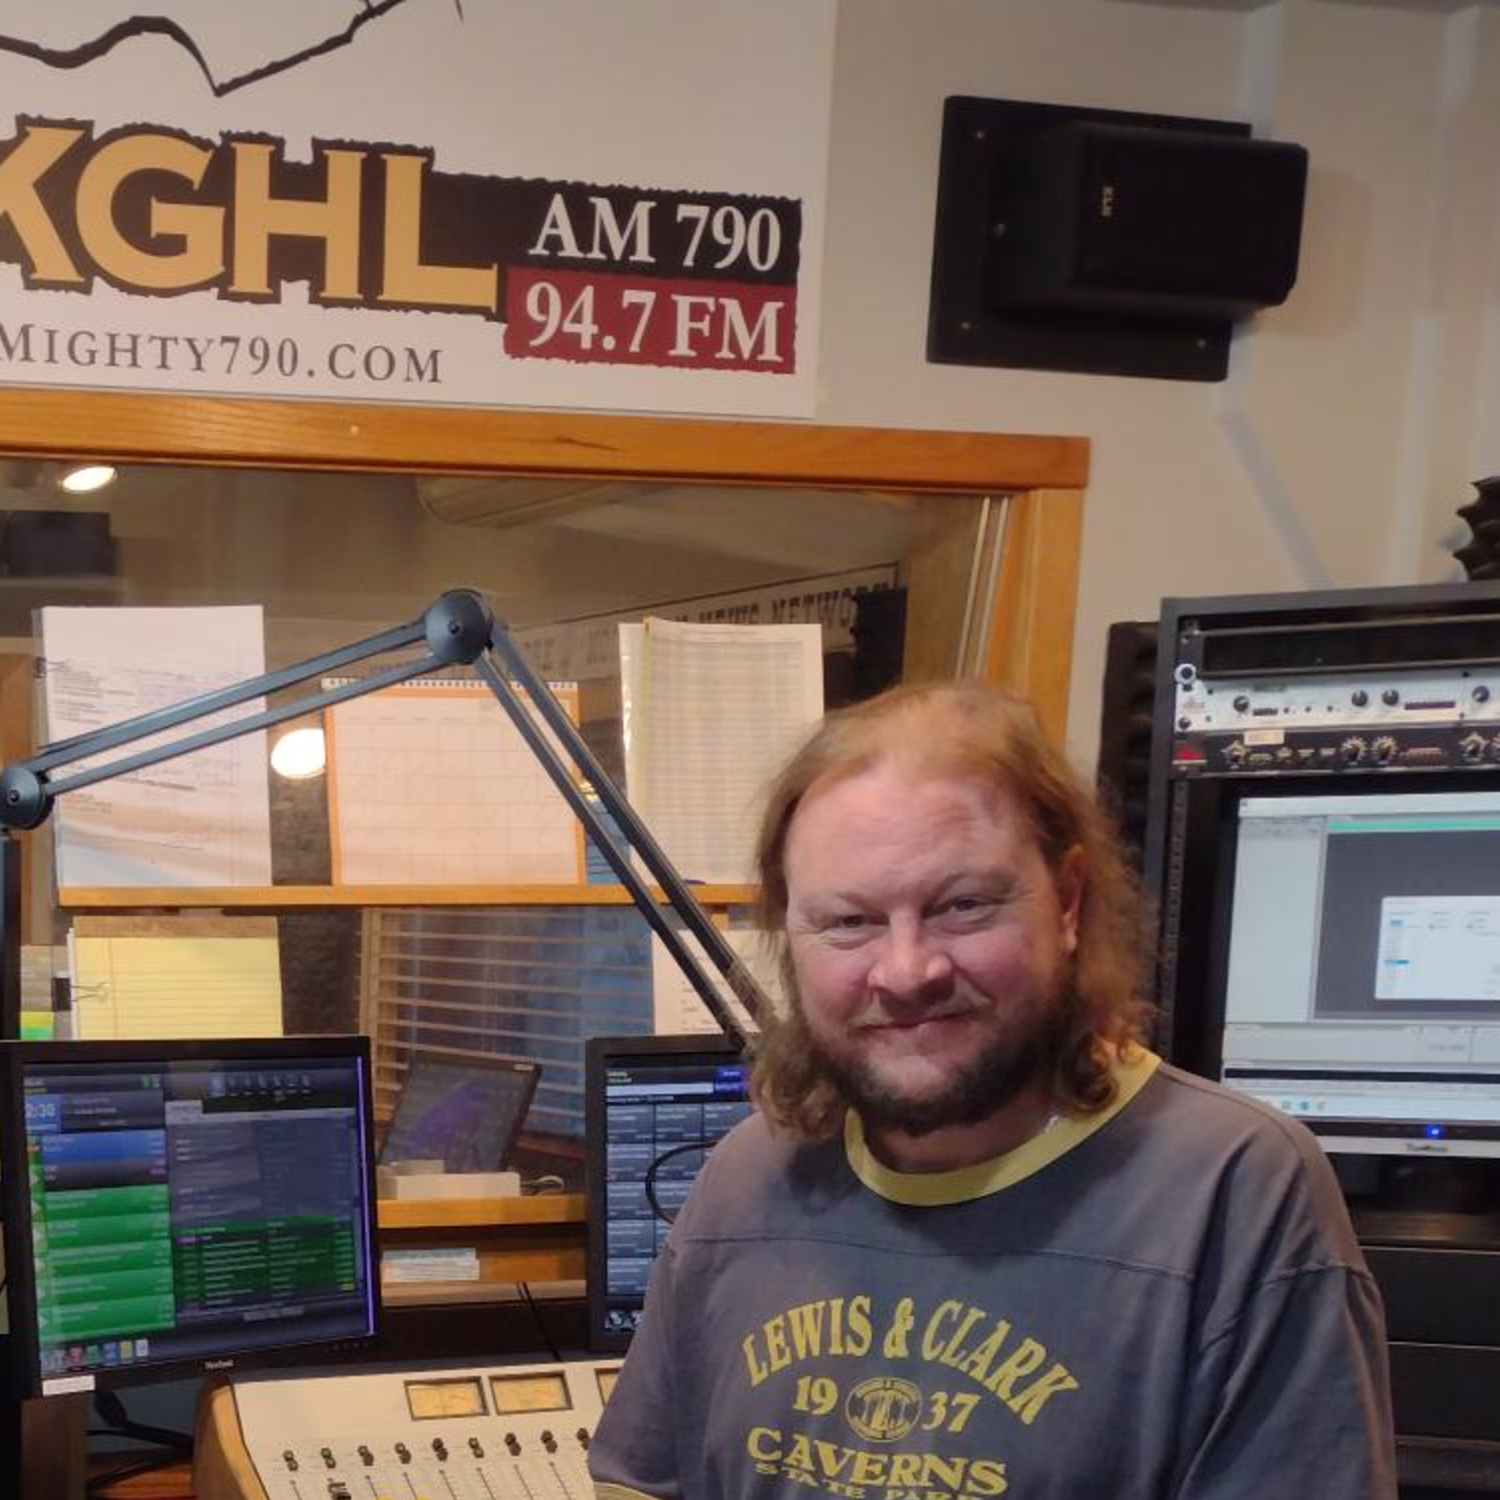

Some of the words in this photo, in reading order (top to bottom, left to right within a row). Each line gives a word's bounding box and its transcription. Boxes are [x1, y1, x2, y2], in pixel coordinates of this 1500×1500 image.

[528, 192, 657, 263] AM
[677, 203, 782, 272] 790
[525, 281, 657, 354] 94.7
[668, 293, 785, 363] FM
[772, 584, 890, 628] NETWO
[742, 1295, 873, 1387] LEWIS
[883, 1297, 915, 1359] &
[922, 1299, 1080, 1425] CLARK
[792, 1375, 839, 1415] 19
[923, 1391, 981, 1433] 37
[747, 1426, 1009, 1497] CAVERNS
